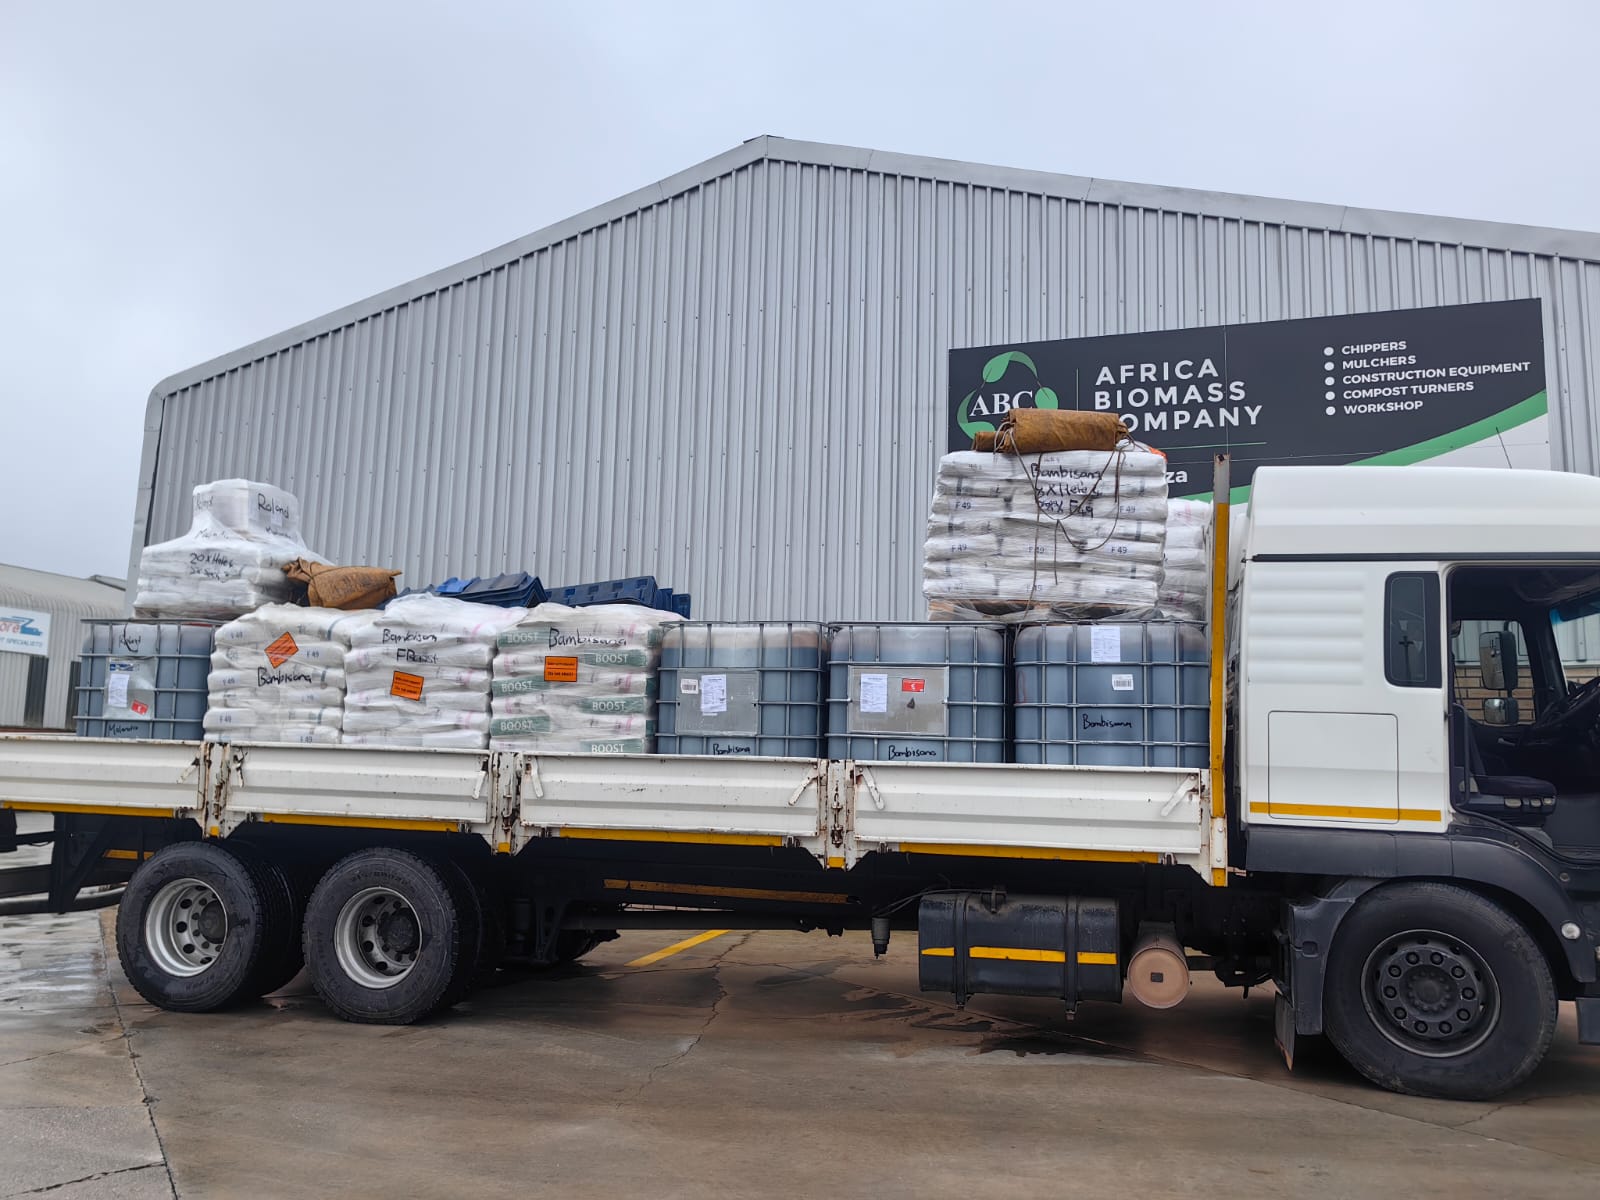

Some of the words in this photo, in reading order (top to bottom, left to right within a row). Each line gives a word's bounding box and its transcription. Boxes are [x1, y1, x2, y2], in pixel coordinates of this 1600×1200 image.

[1341, 341, 1407, 355] CHIPPERS
[1342, 355, 1417, 370] MULCHERS
[1095, 358, 1219, 386] AFRICA
[1342, 368, 1446, 385] CONSTRUCTION
[1449, 362, 1531, 377] EQUIPMENT
[1095, 381, 1246, 410] BIOMASS
[1343, 386, 1408, 400] COMPOST
[1410, 381, 1474, 395] TURNERS
[969, 390, 1033, 417] ABC
[1344, 400, 1423, 415] WORKSHOP
[1119, 405, 1263, 433] OMPANY
[595, 653, 628, 663] BOOST
[501, 681, 532, 692] BOOST
[592, 701, 626, 711] BOOST
[500, 720, 533, 730] BOOST
[591, 743, 625, 753] BOOST
